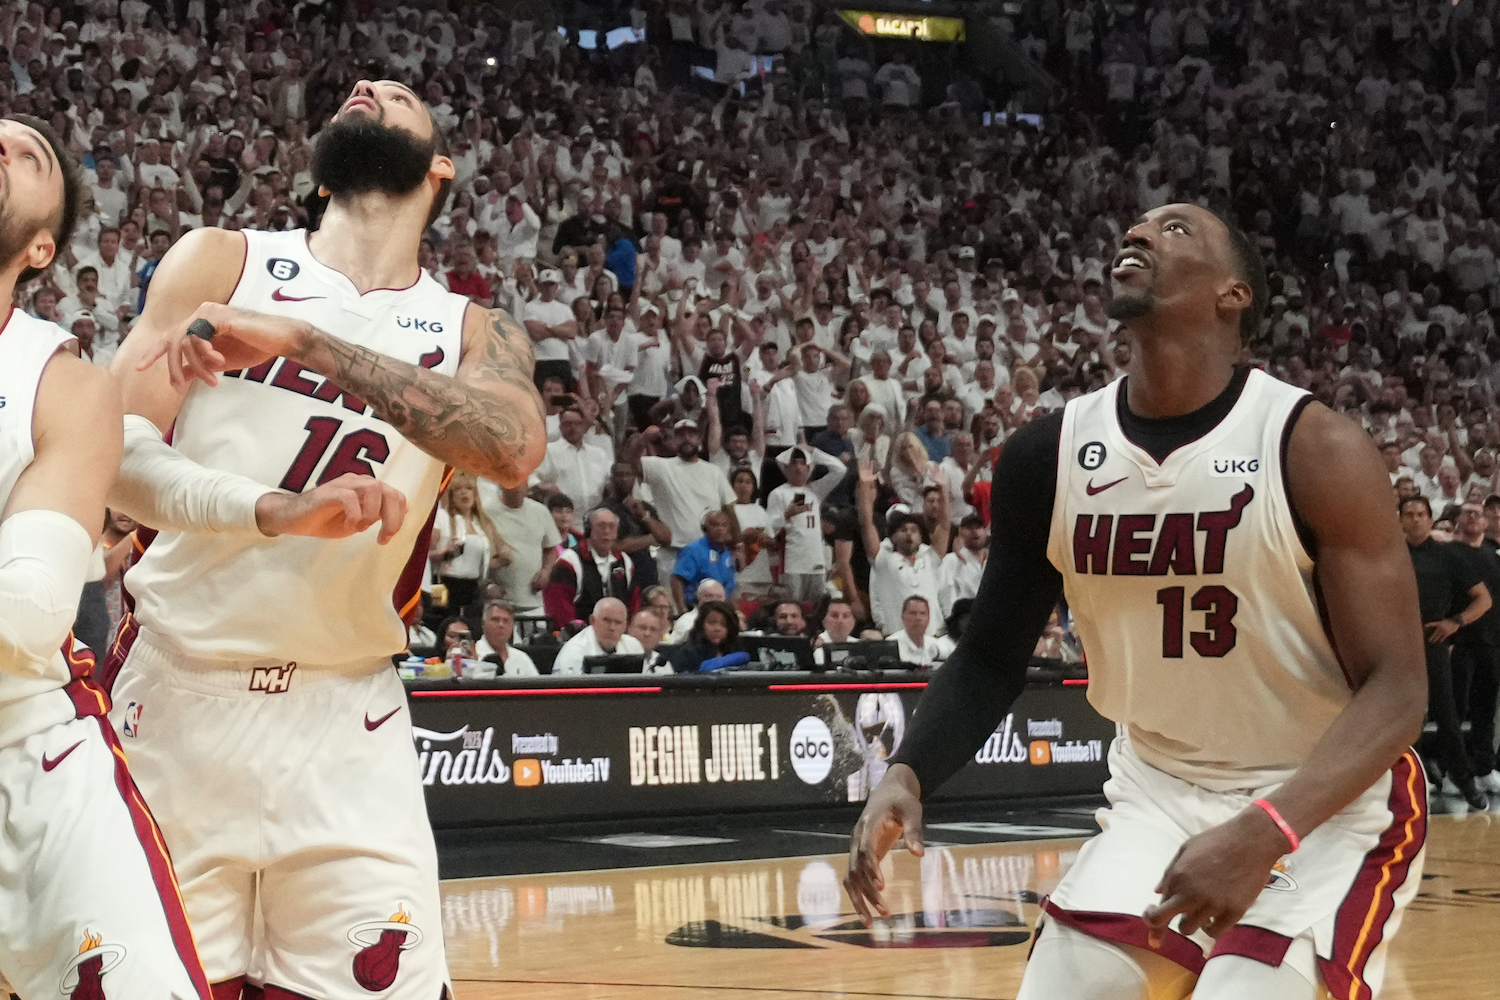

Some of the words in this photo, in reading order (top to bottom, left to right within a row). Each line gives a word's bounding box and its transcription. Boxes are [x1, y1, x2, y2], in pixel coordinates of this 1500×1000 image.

[272, 260, 294, 278] 6
[278, 415, 391, 494] 16
[1083, 445, 1102, 467] 6
[1073, 482, 1255, 576] HEAT
[1156, 585, 1239, 658] 13
[411, 724, 511, 786] inals
[629, 724, 700, 786] BEGIN
[705, 723, 766, 783] JUNE
[767, 722, 779, 780] 1
[794, 736, 830, 759] abc
